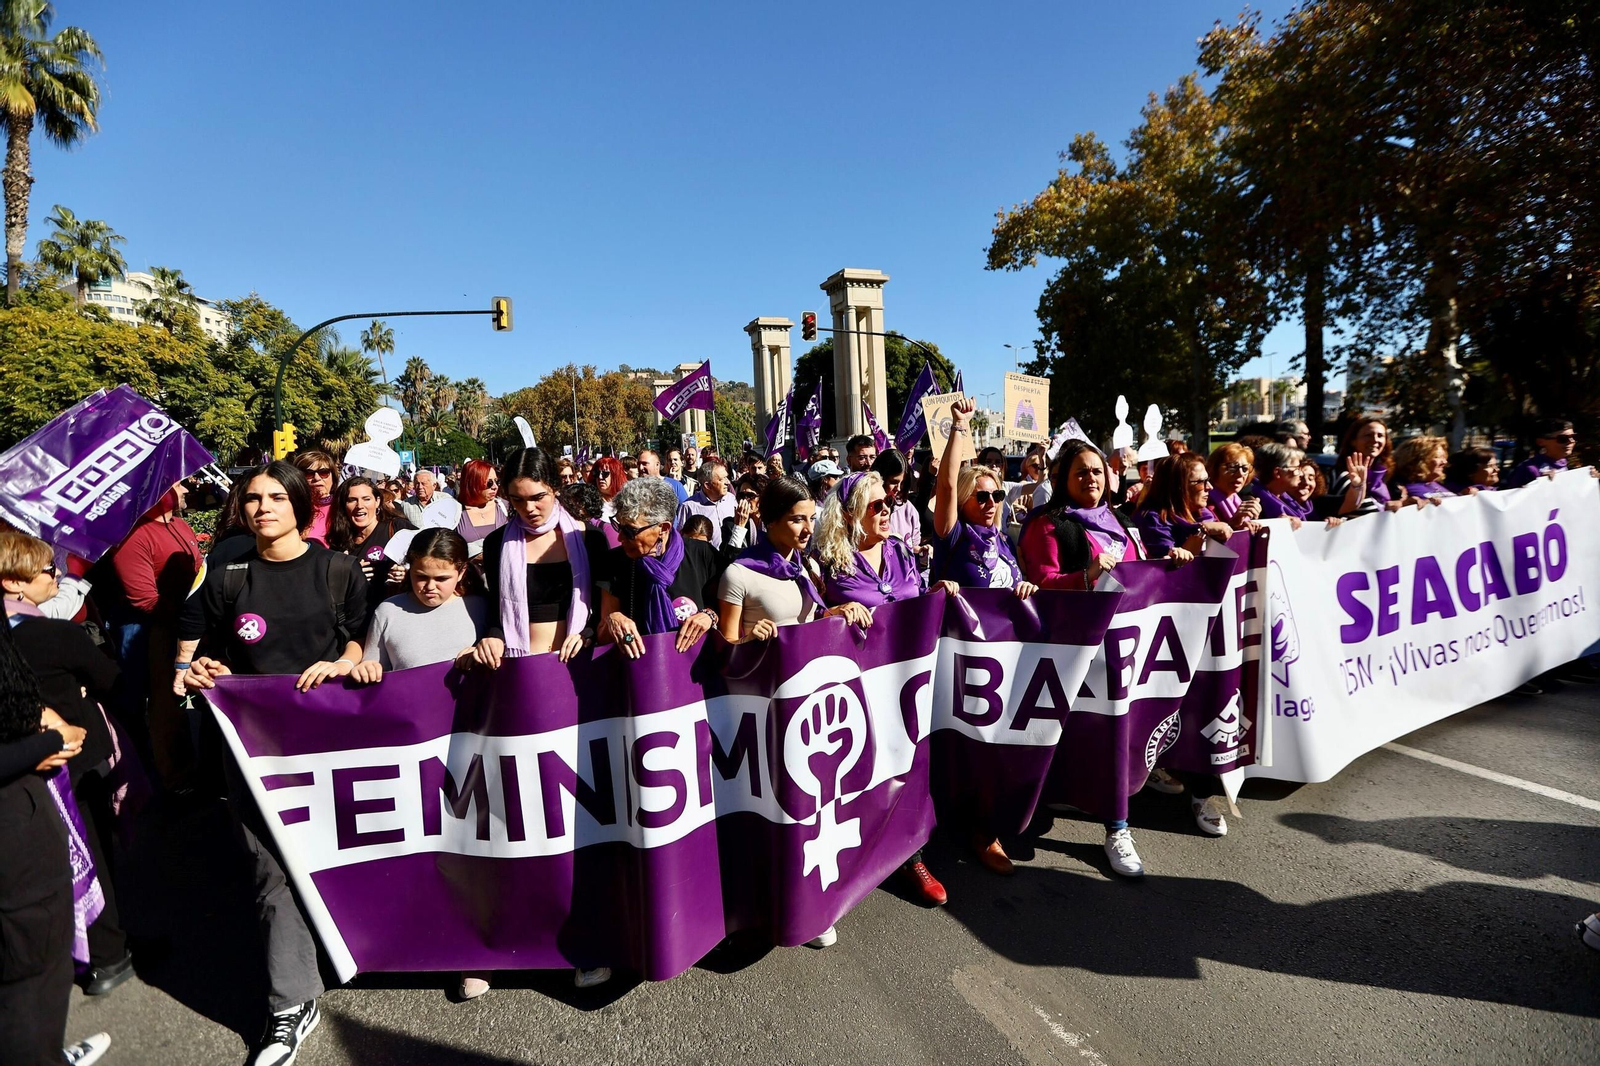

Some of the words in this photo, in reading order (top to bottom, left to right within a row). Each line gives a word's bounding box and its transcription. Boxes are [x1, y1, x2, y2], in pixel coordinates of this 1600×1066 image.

[1013, 384, 1041, 395] DESPIERTA
[1015, 431, 1045, 441] FEMINISTA
[402, 452, 409, 460] P
[1336, 565, 1400, 644] SE
[1411, 508, 1568, 625] ACABÓ
[1388, 641, 1459, 686] ¡Vivas
[1465, 627, 1490, 658] nos
